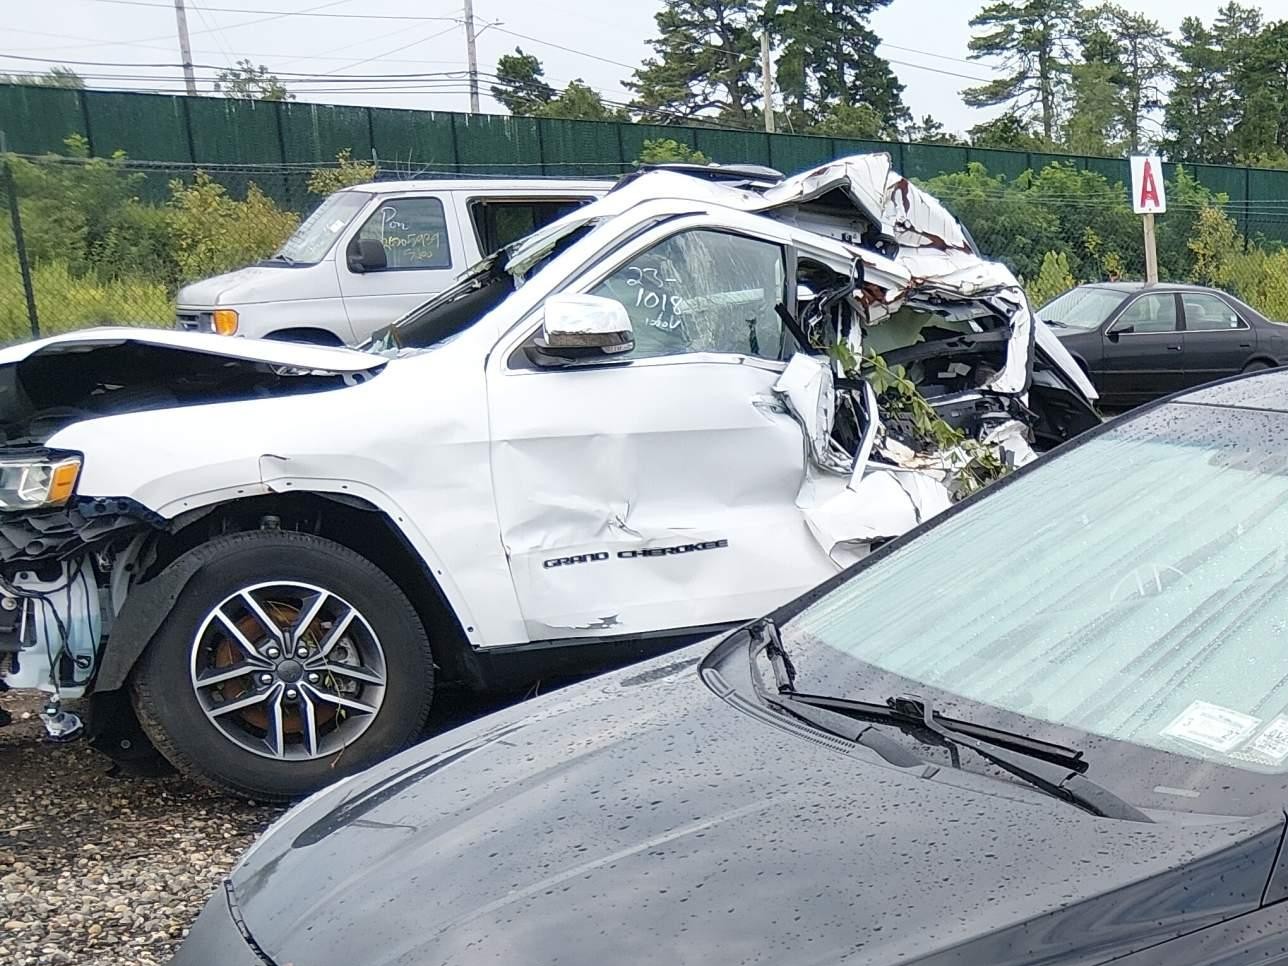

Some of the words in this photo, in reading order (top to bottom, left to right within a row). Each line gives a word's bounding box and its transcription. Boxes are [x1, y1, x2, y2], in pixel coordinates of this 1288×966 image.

[1140, 158, 1160, 208] A
[635, 288, 682, 315] 1018
[543, 551, 610, 569] GRAND
[617, 539, 729, 558] CHEROKEE
